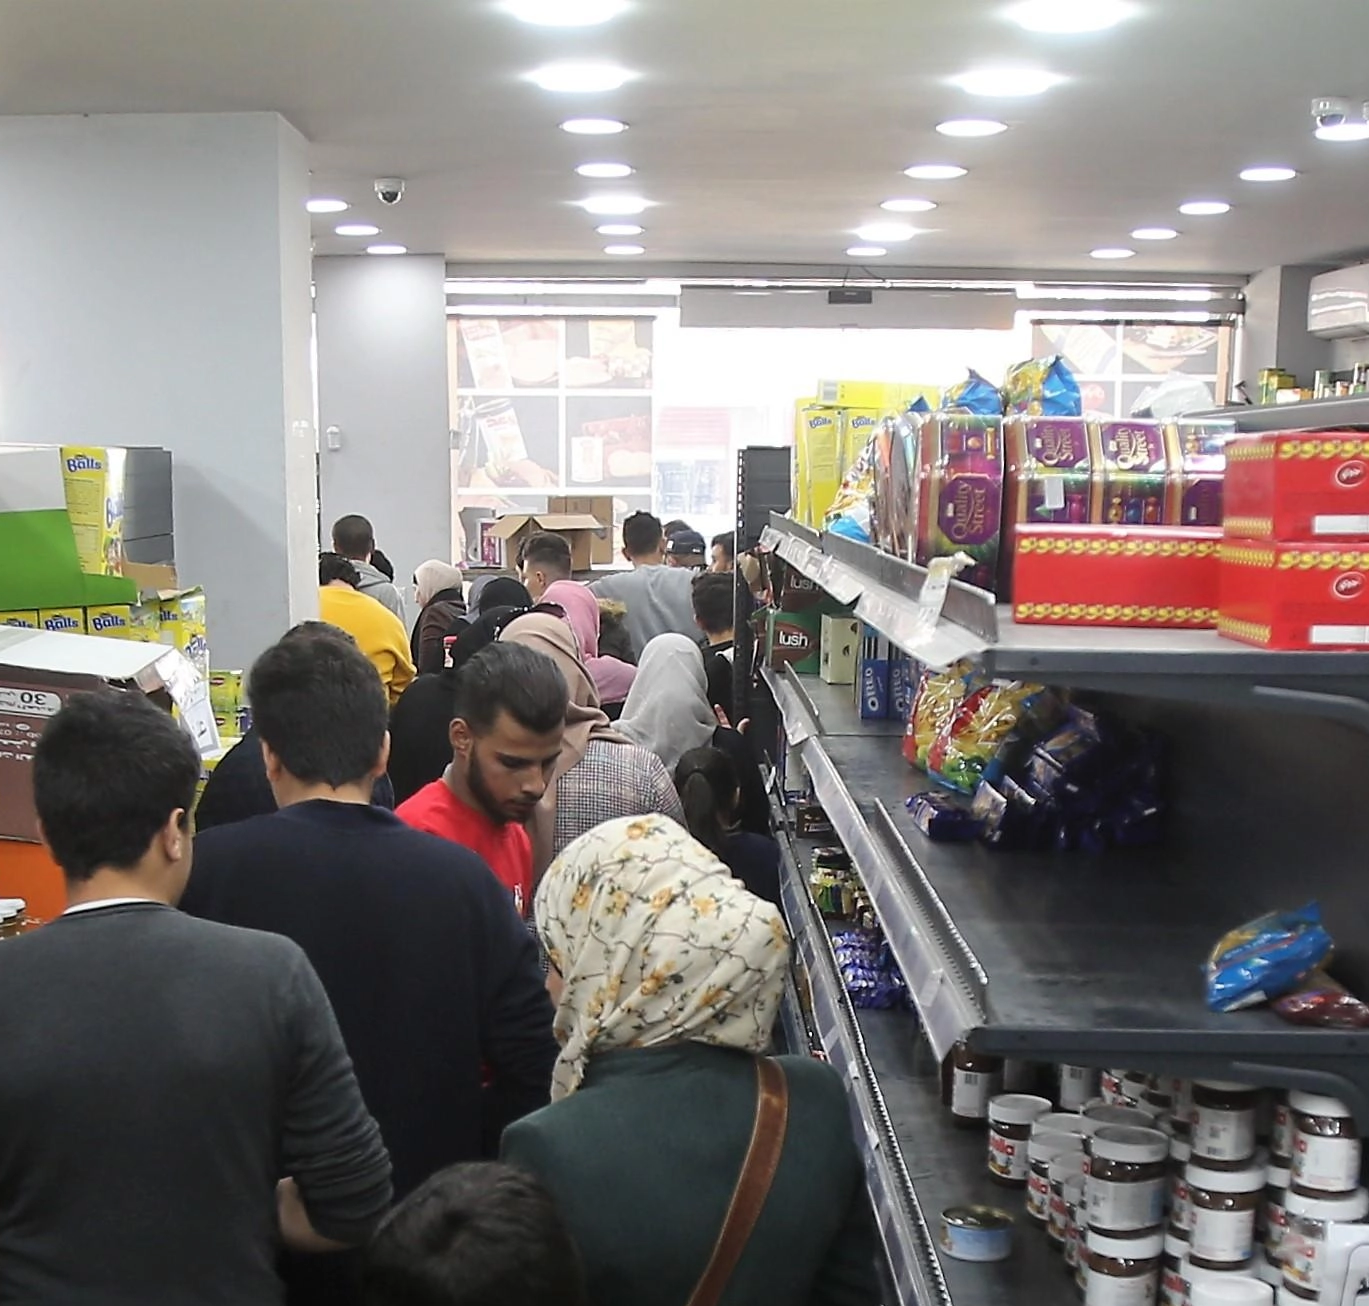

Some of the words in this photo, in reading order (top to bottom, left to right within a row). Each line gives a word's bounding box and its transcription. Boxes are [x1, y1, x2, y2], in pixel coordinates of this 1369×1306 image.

[67, 456, 102, 472] Balls
[1116, 427, 1137, 470] Quality
[1132, 429, 1150, 467] Street
[951, 480, 974, 538] Quality
[969, 487, 988, 536] Street
[92, 614, 126, 631] Balls
[779, 631, 809, 647] lush
[20, 691, 47, 706] 30
[865, 667, 880, 712] OREO
